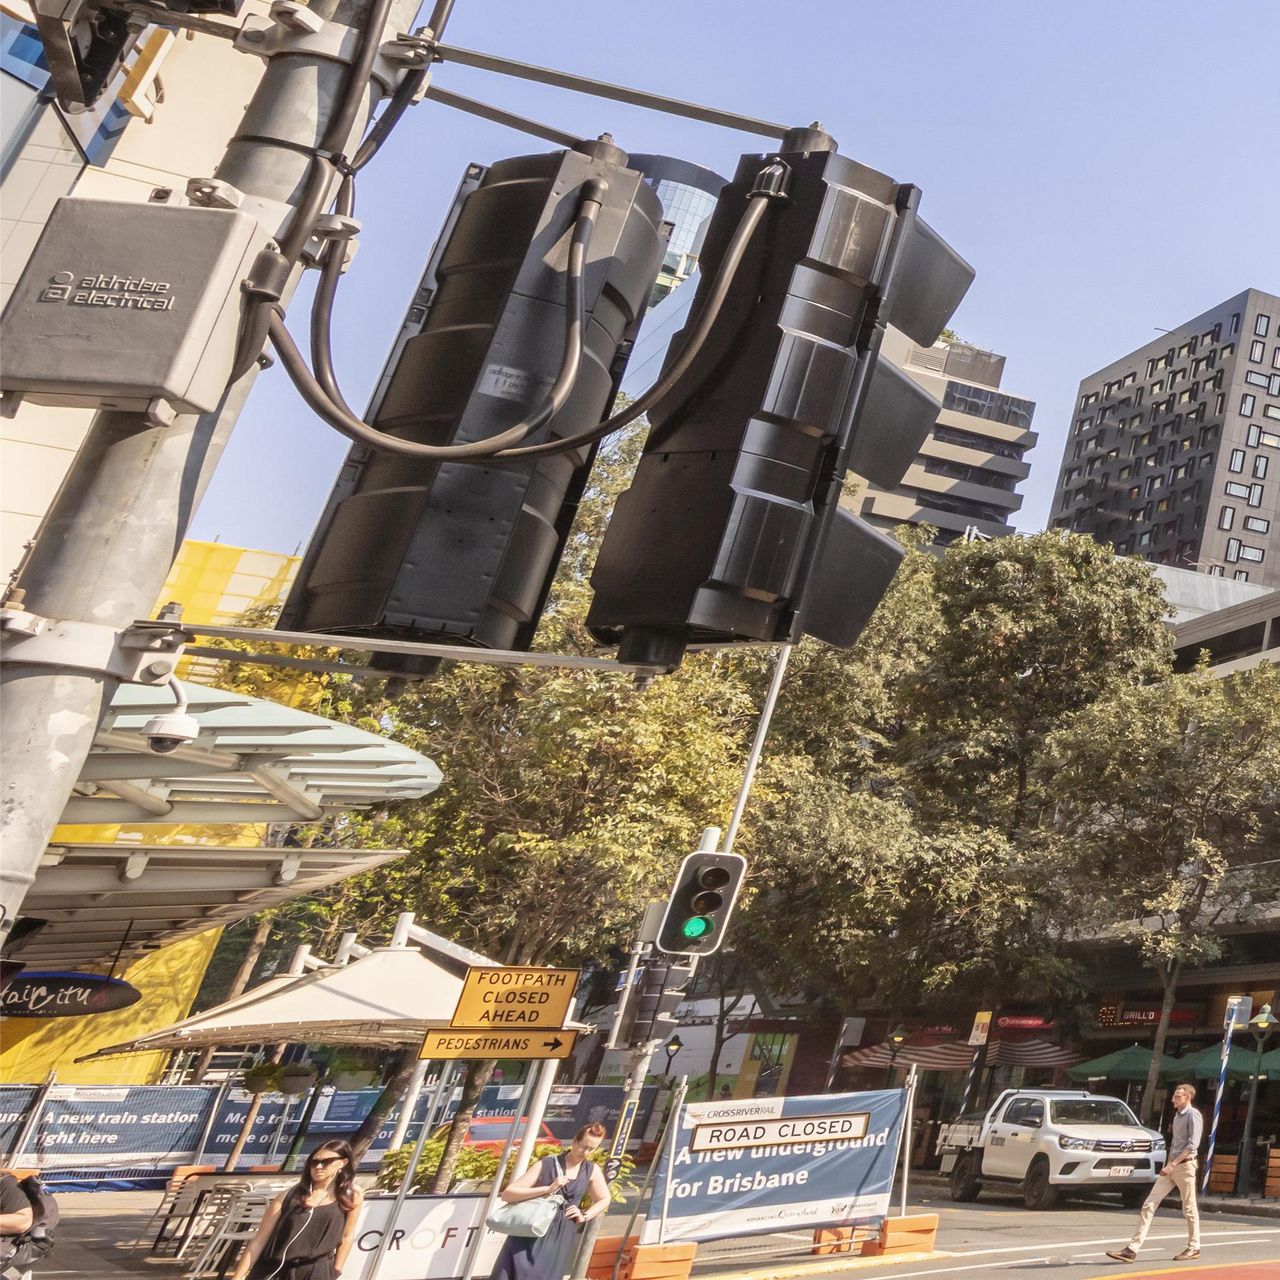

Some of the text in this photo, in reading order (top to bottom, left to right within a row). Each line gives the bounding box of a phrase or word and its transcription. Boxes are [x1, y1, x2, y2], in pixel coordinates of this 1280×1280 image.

[80, 274, 170, 294] aldridge
[72, 290, 175, 311] electrical
[477, 972, 567, 986] FOOTPATH
[482, 991, 549, 1004] CLOSED
[478, 1010, 539, 1023] AHEAD
[1123, 1011, 1155, 1020] GRILL'D
[436, 1038, 530, 1050] PEDESTRIANS
[41, 1111, 198, 1124] A new train station
[225, 1112, 265, 1124] Moe
[706, 1106, 775, 1119] CROSSRIVERRAIL
[216, 1133, 256, 1143] moe
[709, 1120, 853, 1143] ROAD CLOSED
[33, 1131, 118, 1146] right here
[674, 1128, 890, 1166] A new underground
[668, 1169, 809, 1199] for Brisbane
[358, 1227, 480, 1253] CROFT
